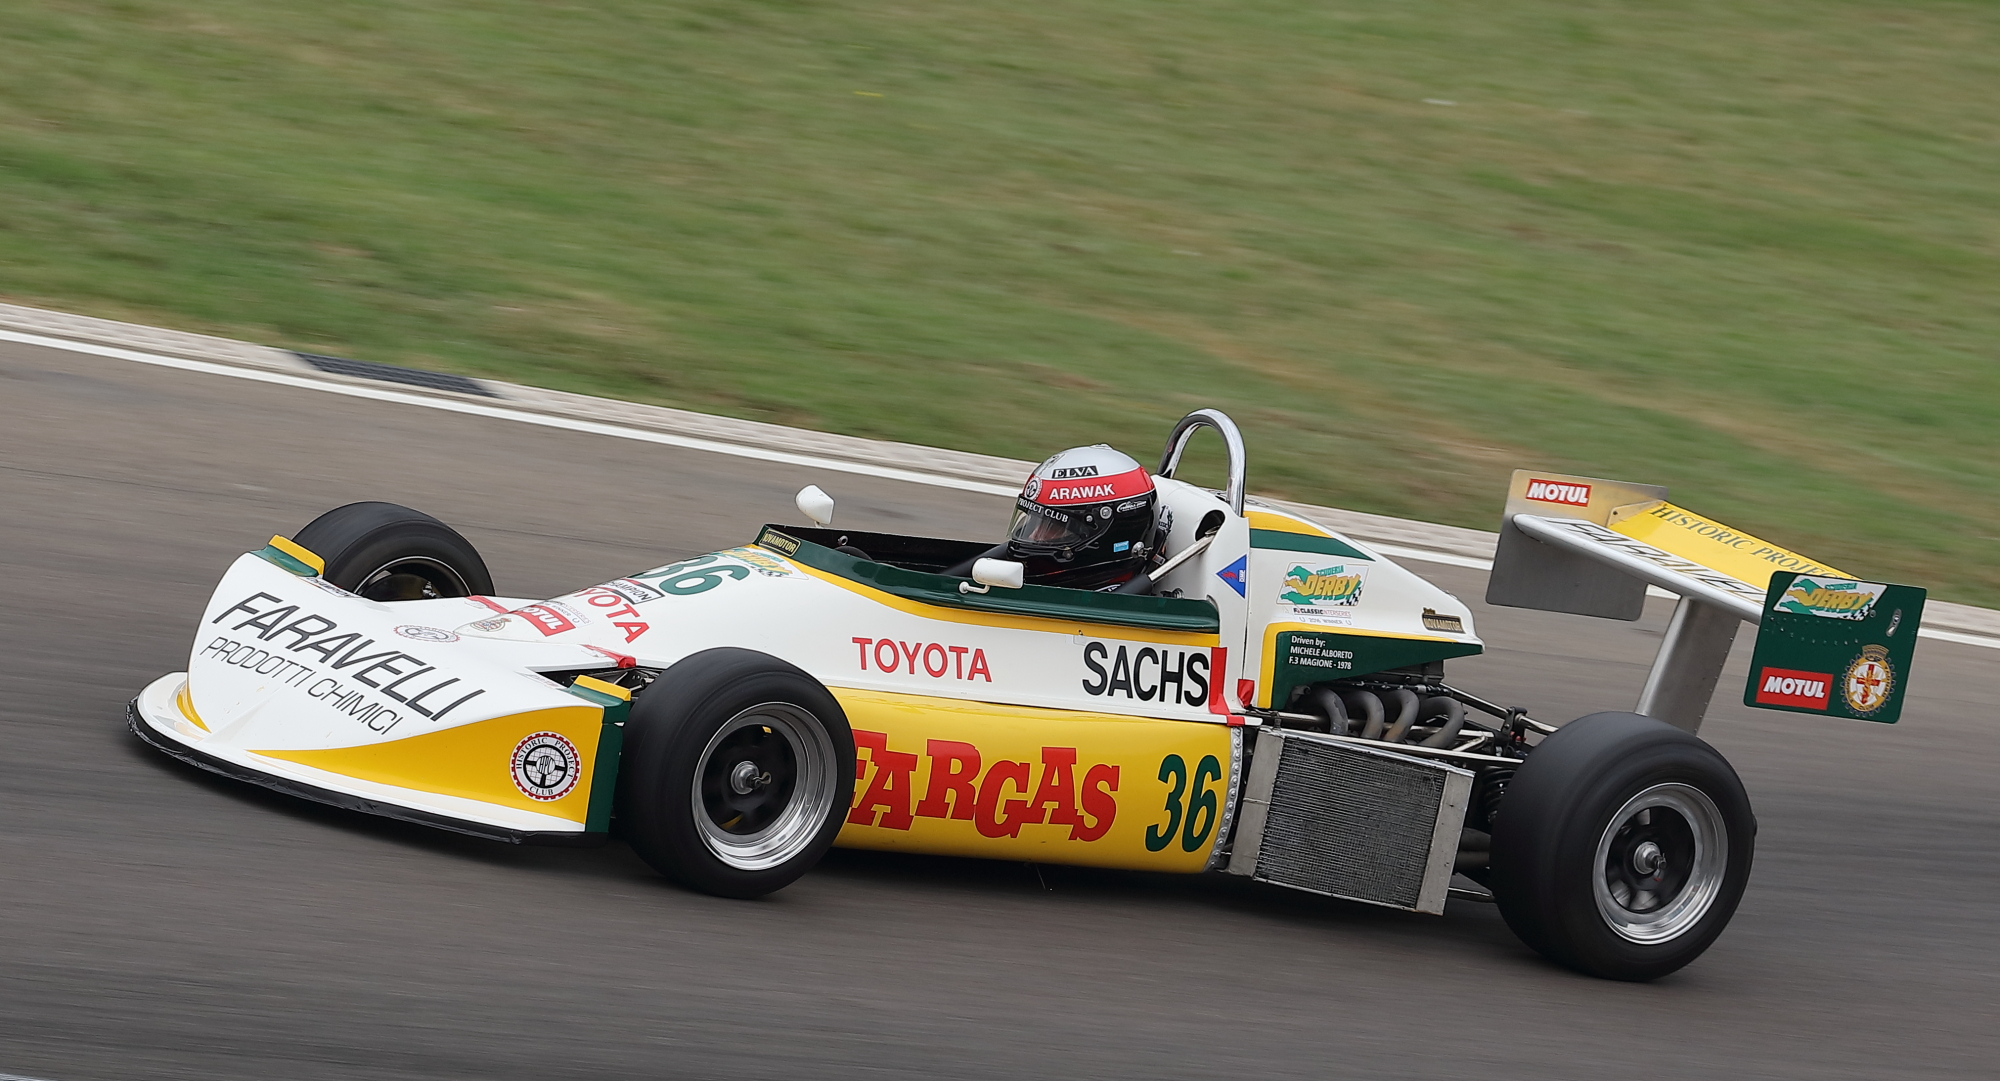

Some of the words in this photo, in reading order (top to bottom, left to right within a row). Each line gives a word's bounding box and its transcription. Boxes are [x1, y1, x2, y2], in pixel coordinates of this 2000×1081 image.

[1054, 467, 1097, 478] ELVA
[1049, 484, 1115, 500] ARAWAK
[1527, 481, 1589, 504] MOTUL
[1044, 508, 1069, 523] CLUB
[1649, 505, 1755, 550] HISTORIC
[1749, 546, 1838, 578] PROJE
[1305, 573, 1361, 597] DERBY
[520, 606, 564, 630] OTUL
[1290, 646, 1321, 657] MICHELE
[1321, 649, 1353, 659] ALBORETO
[1291, 635, 1314, 646] Driven
[1315, 638, 1326, 647] by:
[212, 591, 486, 721] FARAVELLI
[852, 637, 992, 683] TOYOTA
[1289, 656, 1299, 665] F.3
[1300, 657, 1333, 668] MAGIONE
[1337, 661, 1352, 670] 1978
[1082, 641, 1210, 707] SACHS
[199, 637, 317, 687] PRODOTTI
[307, 678, 404, 735] CHIMICI
[1763, 676, 1825, 698] MOTUL
[516, 737, 548, 770] HISTORIC
[554, 740, 575, 779] PROJECT
[529, 786, 554, 796] CLUB
[1145, 753, 1222, 853] 36
